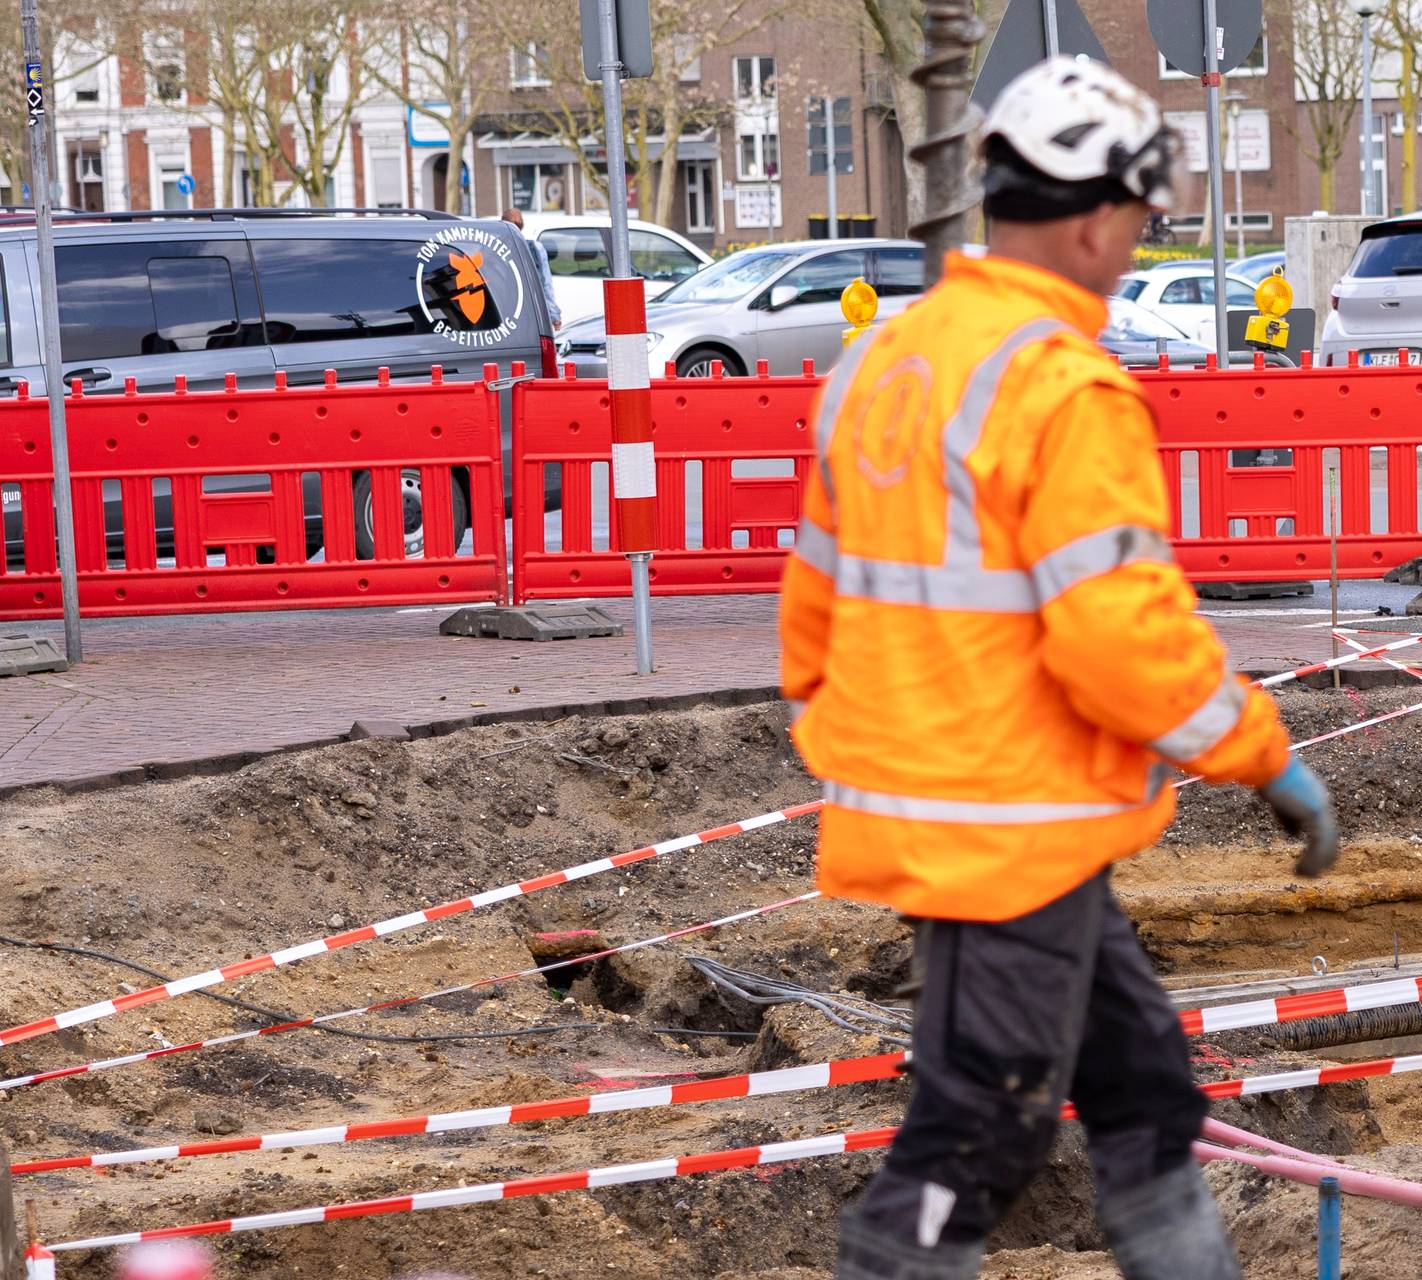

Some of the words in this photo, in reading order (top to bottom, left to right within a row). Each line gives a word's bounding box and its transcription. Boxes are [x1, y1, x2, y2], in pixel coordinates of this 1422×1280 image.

[416, 238, 440, 263] TOM
[435, 227, 512, 262] KAMPFMITTEL
[433, 317, 517, 347] BESEITIGUNG
[2, 491, 22, 505] gun
